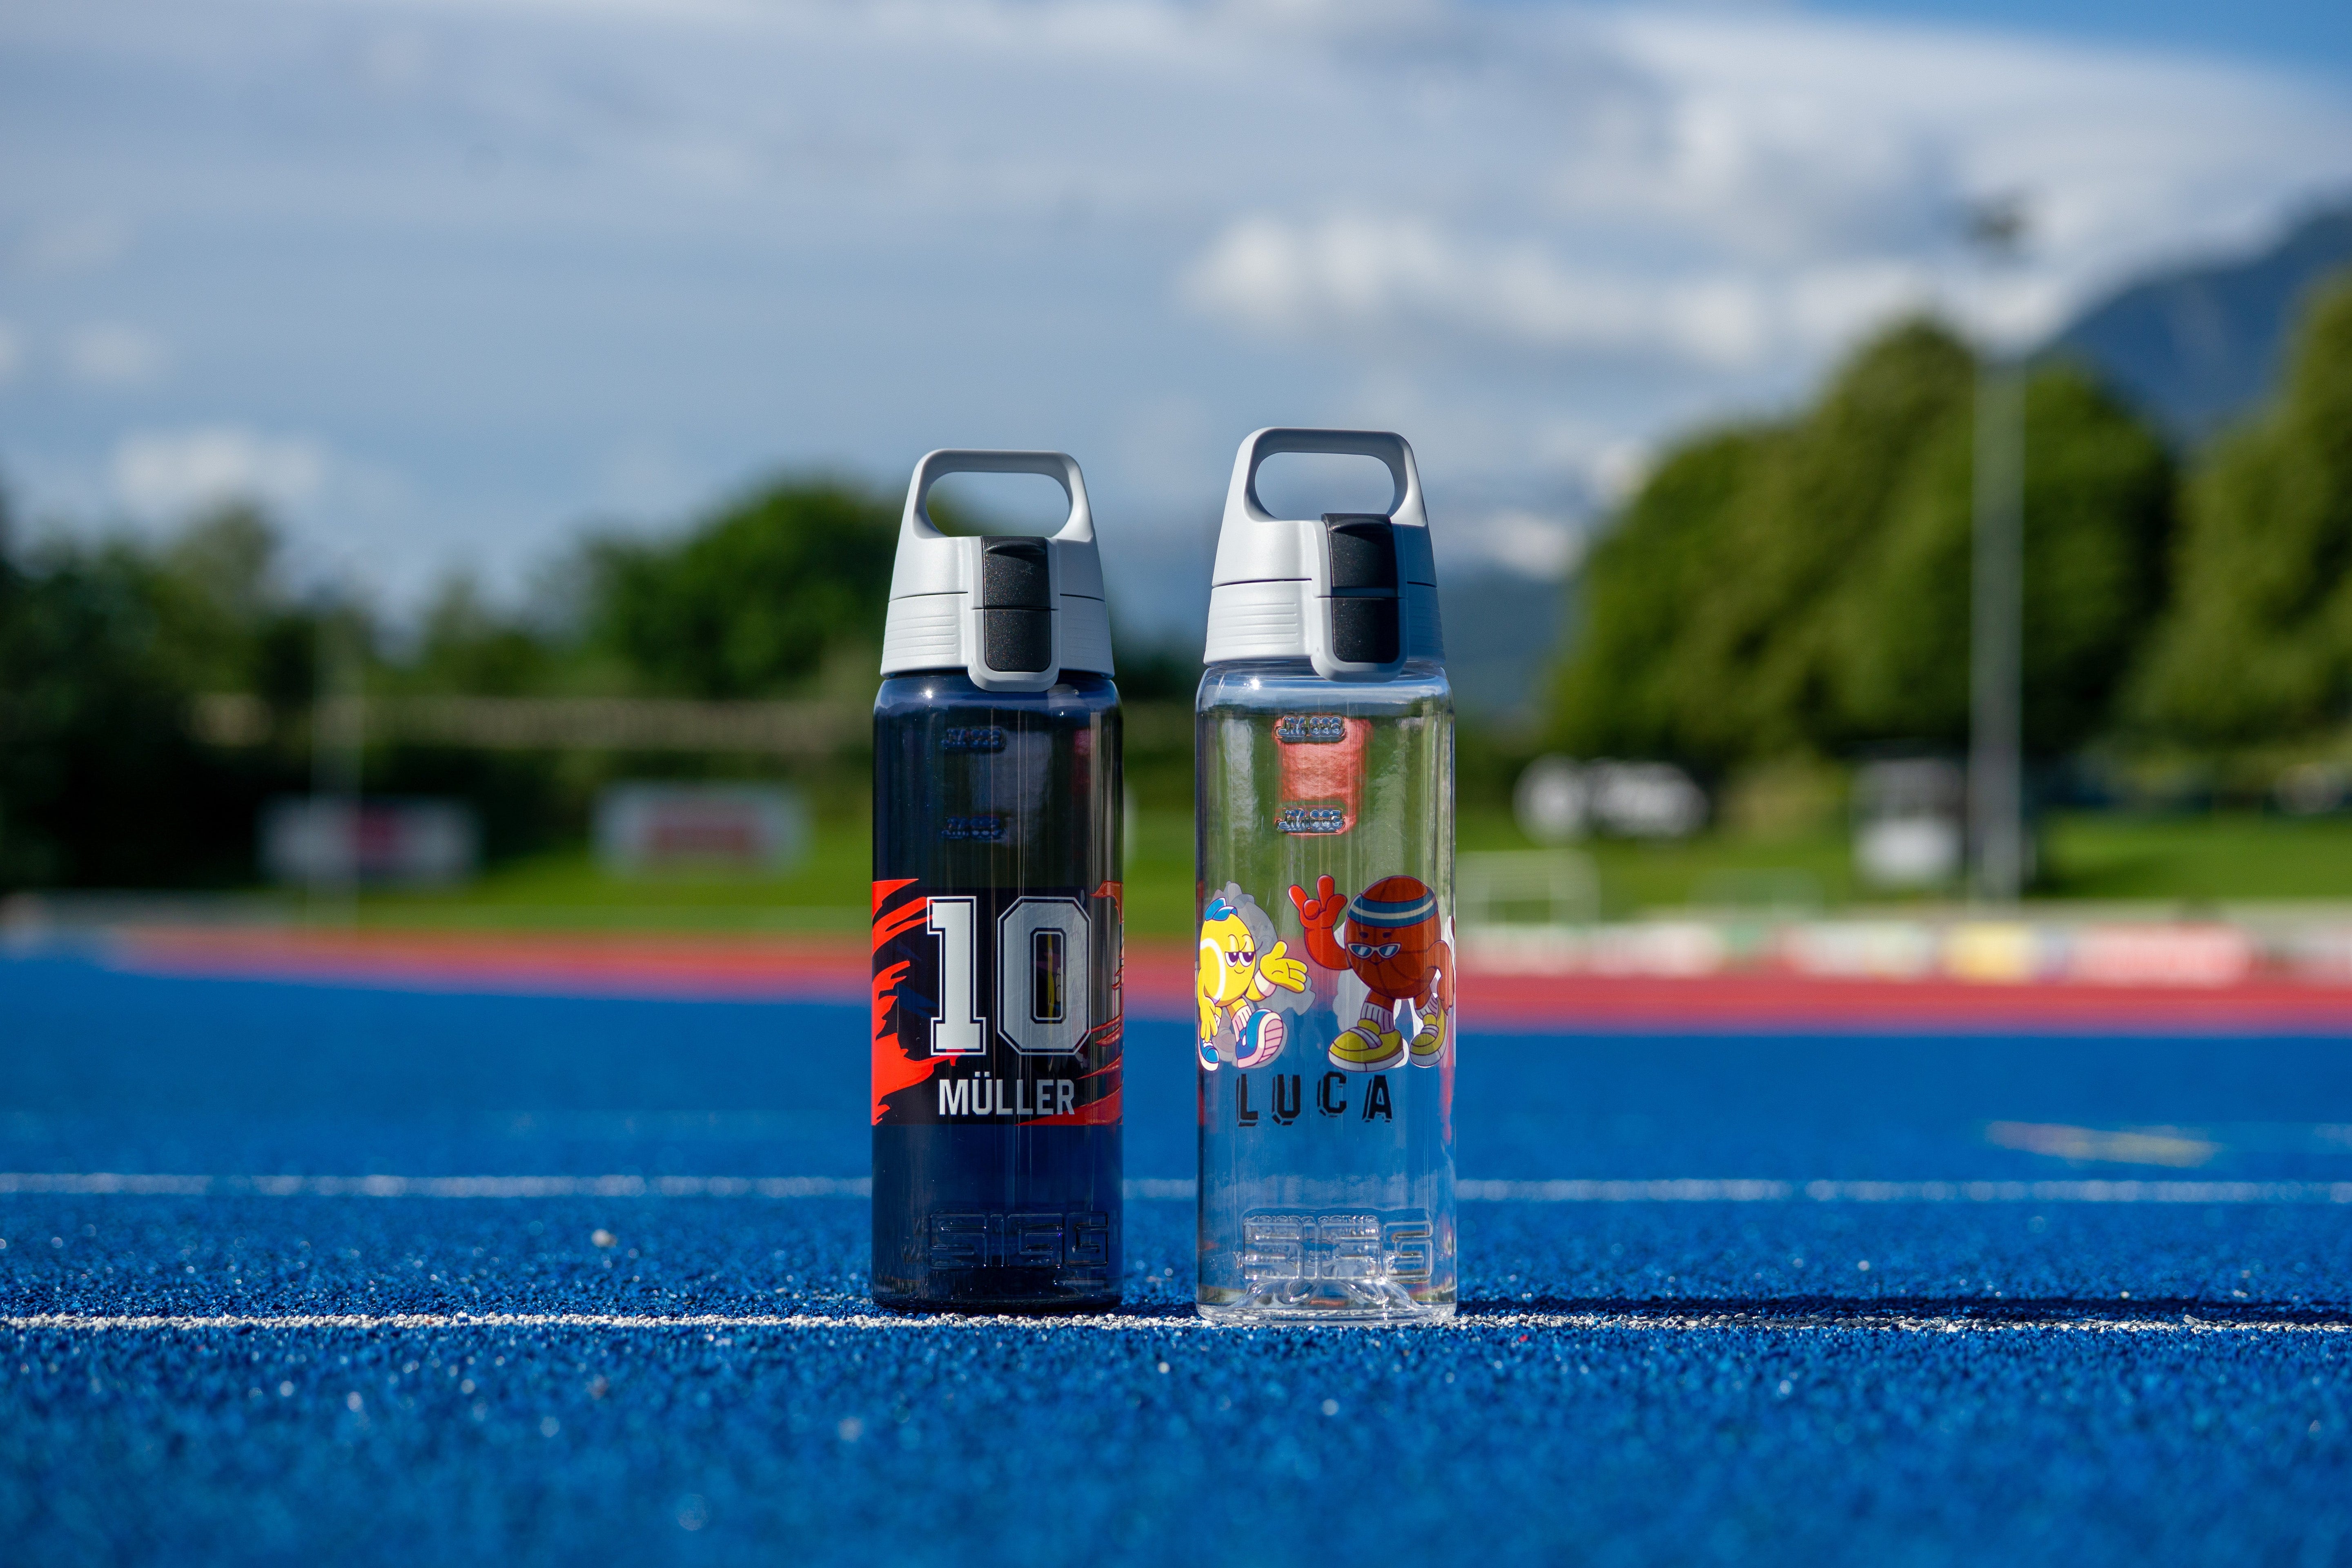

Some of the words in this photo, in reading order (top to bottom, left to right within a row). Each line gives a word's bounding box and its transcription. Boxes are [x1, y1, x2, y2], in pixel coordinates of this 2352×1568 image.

[927, 896, 1091, 1056] 10
[939, 1071, 1075, 1115] MÜLLER
[1236, 1071, 1393, 1127] LUCA
[930, 1211, 1108, 1269] SIGG
[1243, 1221, 1433, 1280] SIGG
